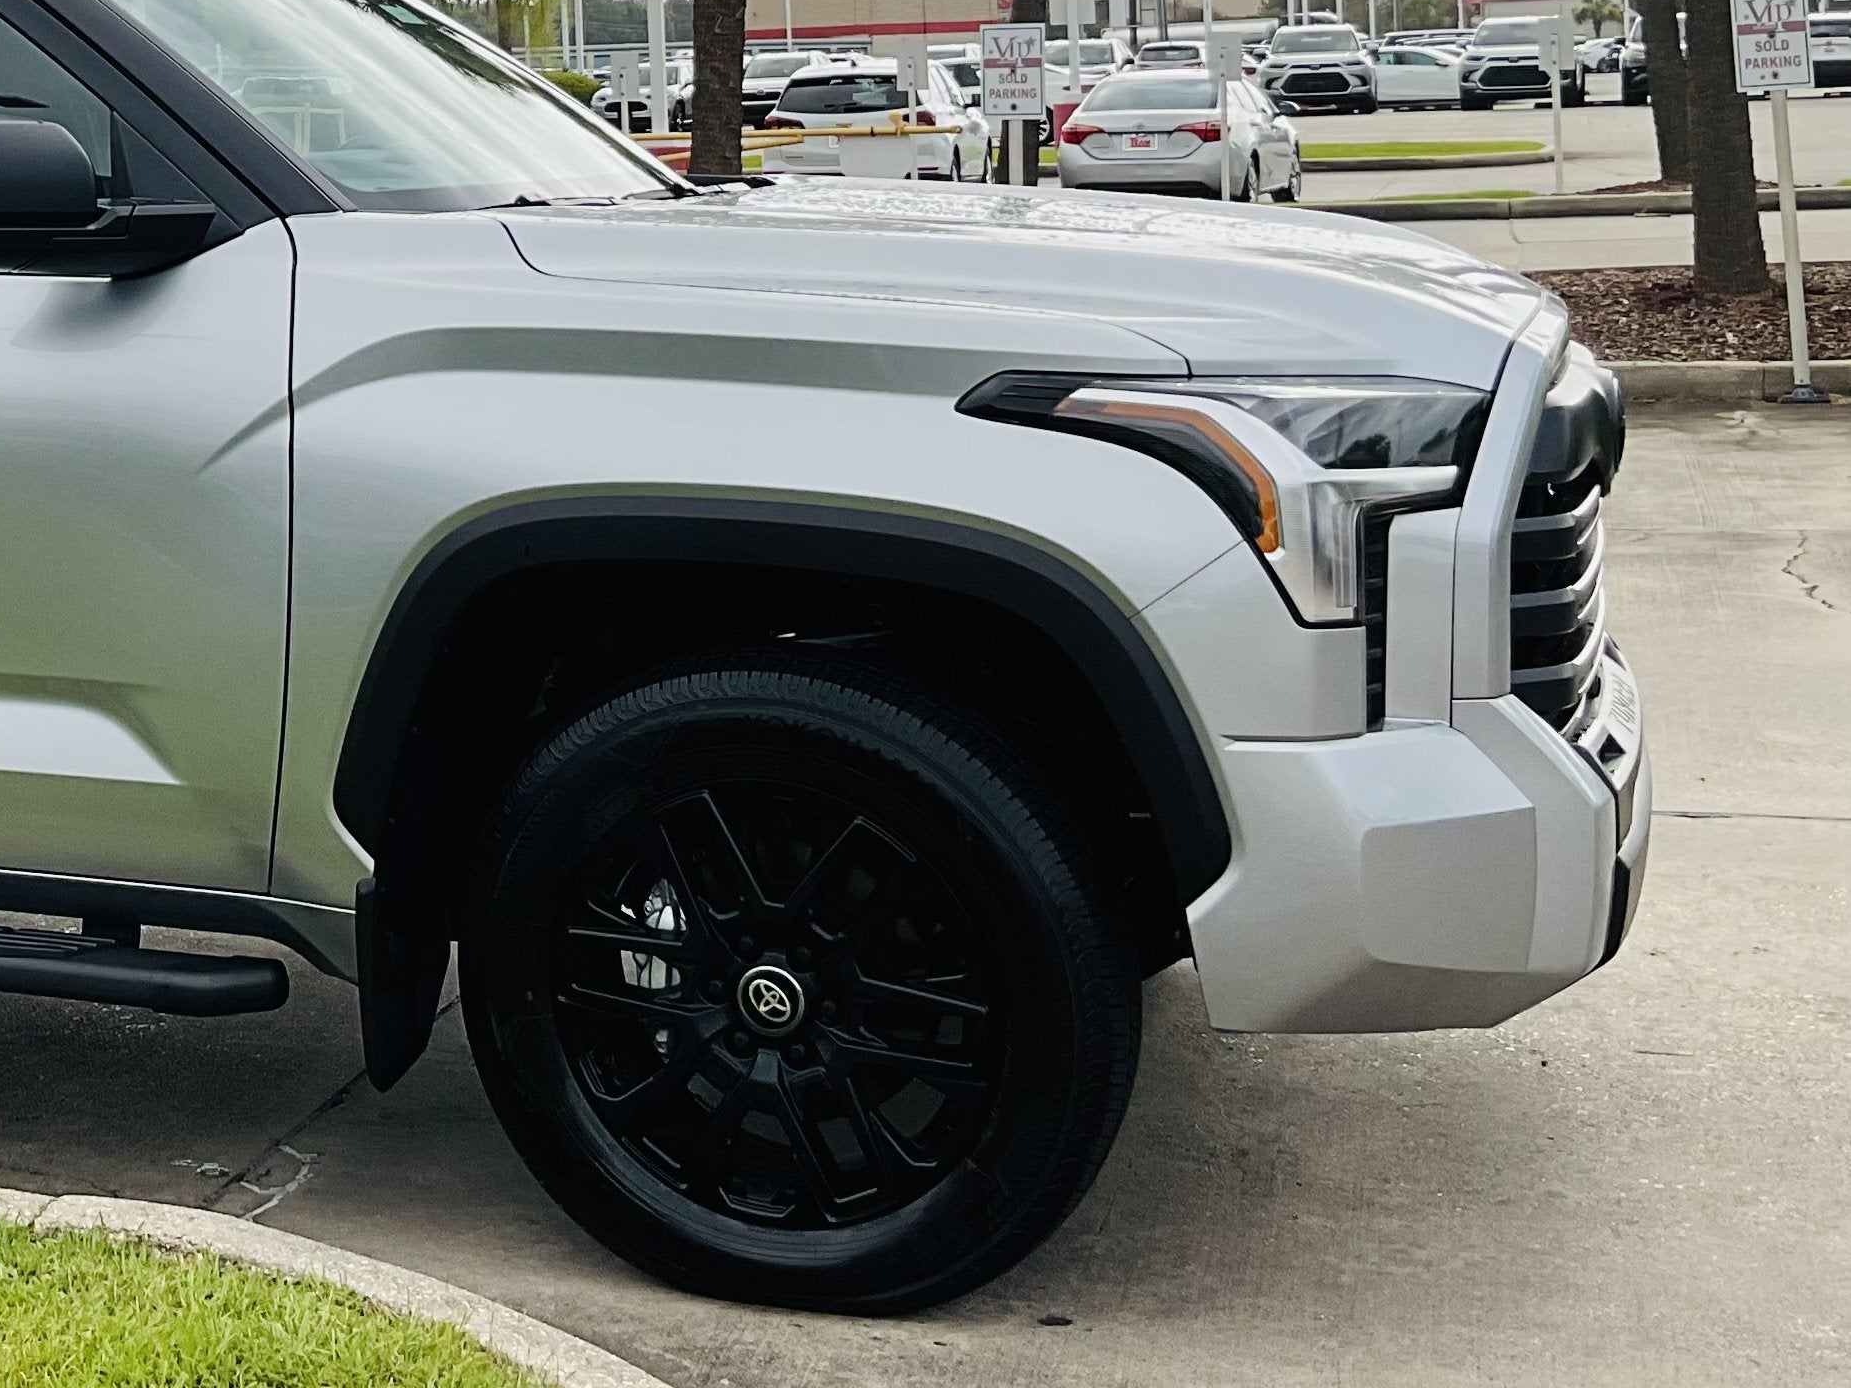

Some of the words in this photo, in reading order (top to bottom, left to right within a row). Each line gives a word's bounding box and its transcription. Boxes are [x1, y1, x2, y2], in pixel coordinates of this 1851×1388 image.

[1755, 39, 1789, 52] SOLD
[1745, 55, 1802, 69] PARKING
[998, 73, 1028, 84] SOLD
[989, 88, 1037, 99] PARKING
